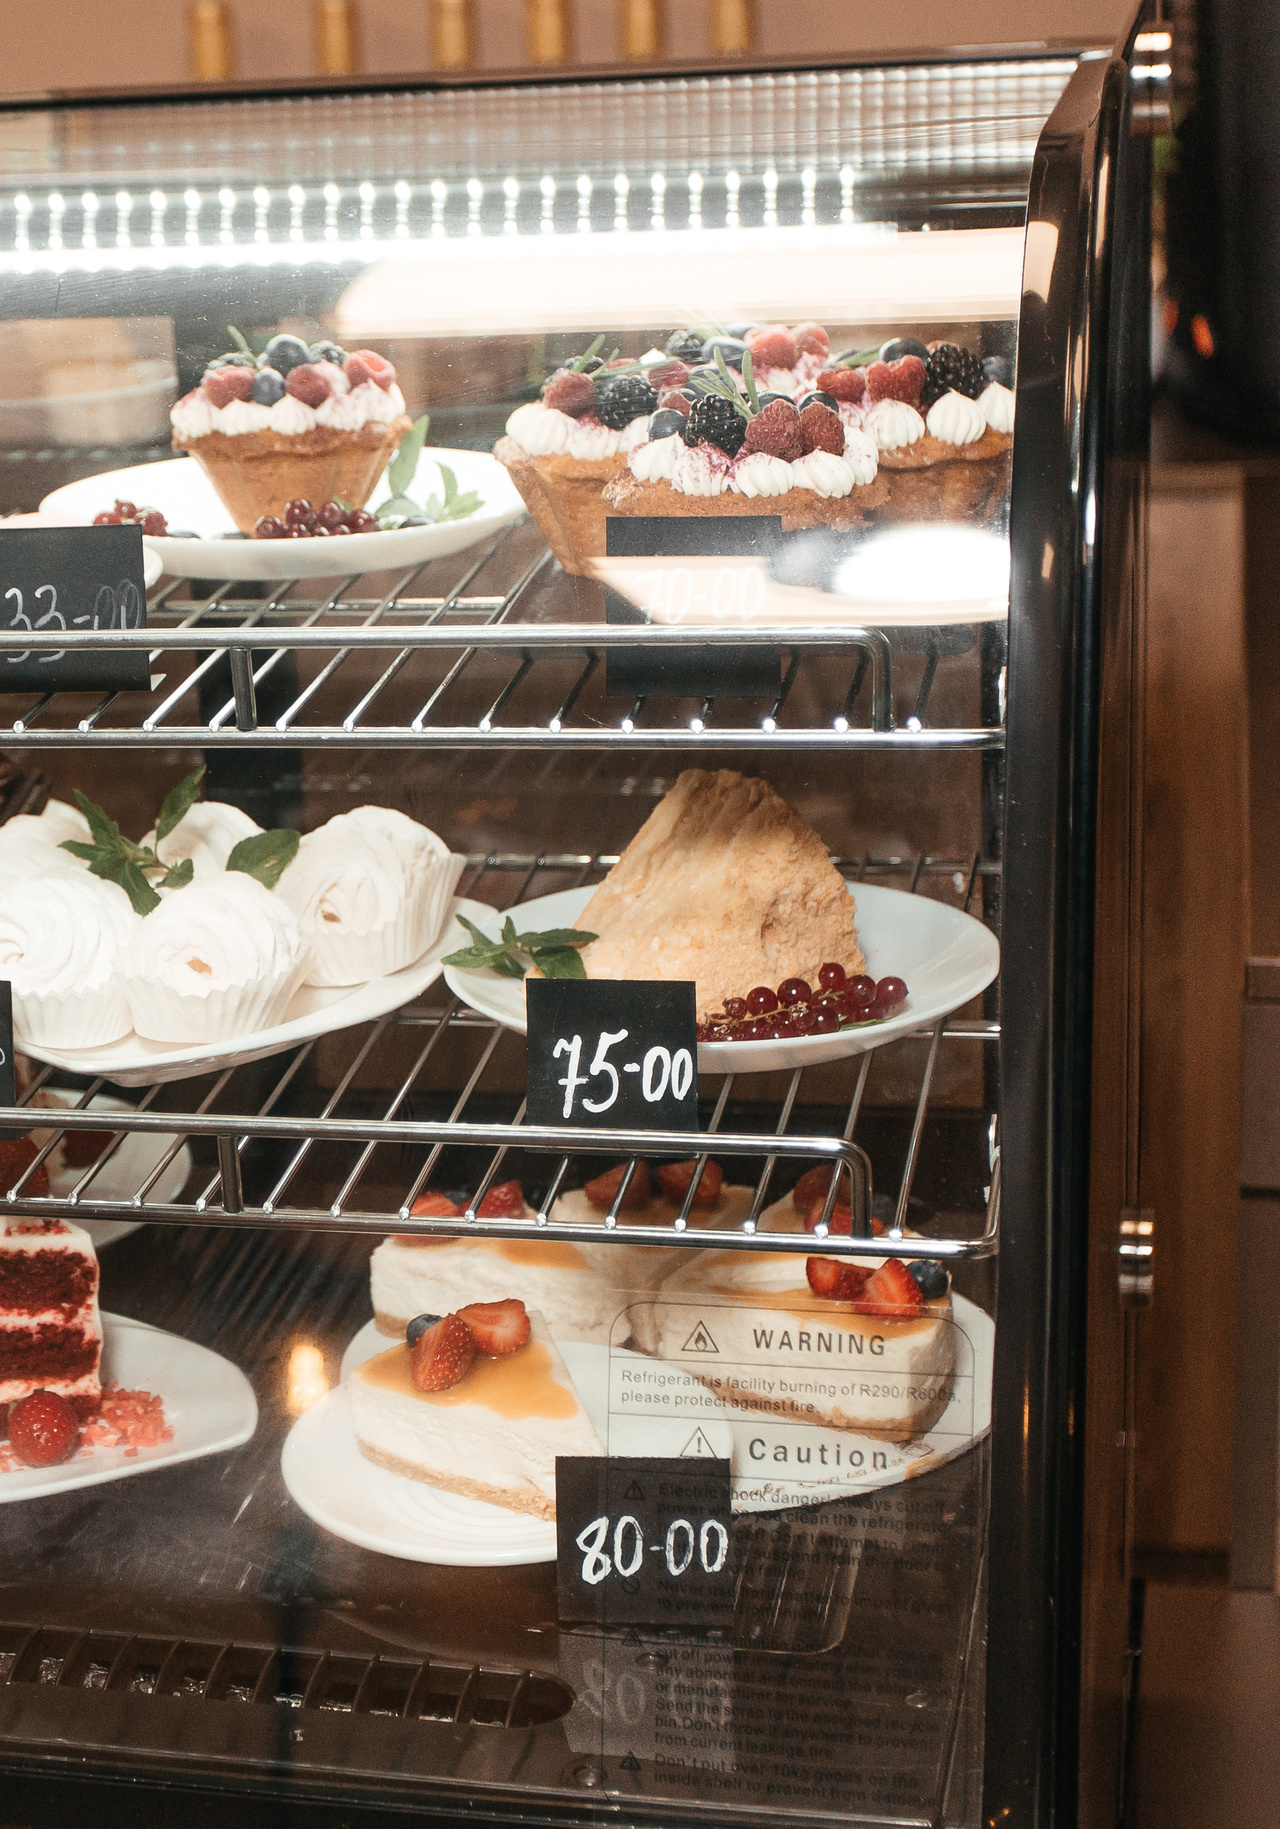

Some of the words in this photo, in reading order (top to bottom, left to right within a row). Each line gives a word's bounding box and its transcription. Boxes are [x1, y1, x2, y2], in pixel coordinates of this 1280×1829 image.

[552, 1028, 694, 1118] 75-00
[752, 1328, 886, 1356] WARNING
[621, 1369, 709, 1391] Refrigerant
[710, 1375, 723, 1389] is
[726, 1375, 777, 1396] facility
[779, 1380, 837, 1399] burning
[841, 1384, 856, 1396] of
[621, 1389, 670, 1407] please
[674, 1392, 727, 1412] protect
[730, 1397, 787, 1416] against
[748, 1437, 889, 1470] Caution
[575, 1515, 728, 1585] 80-00
